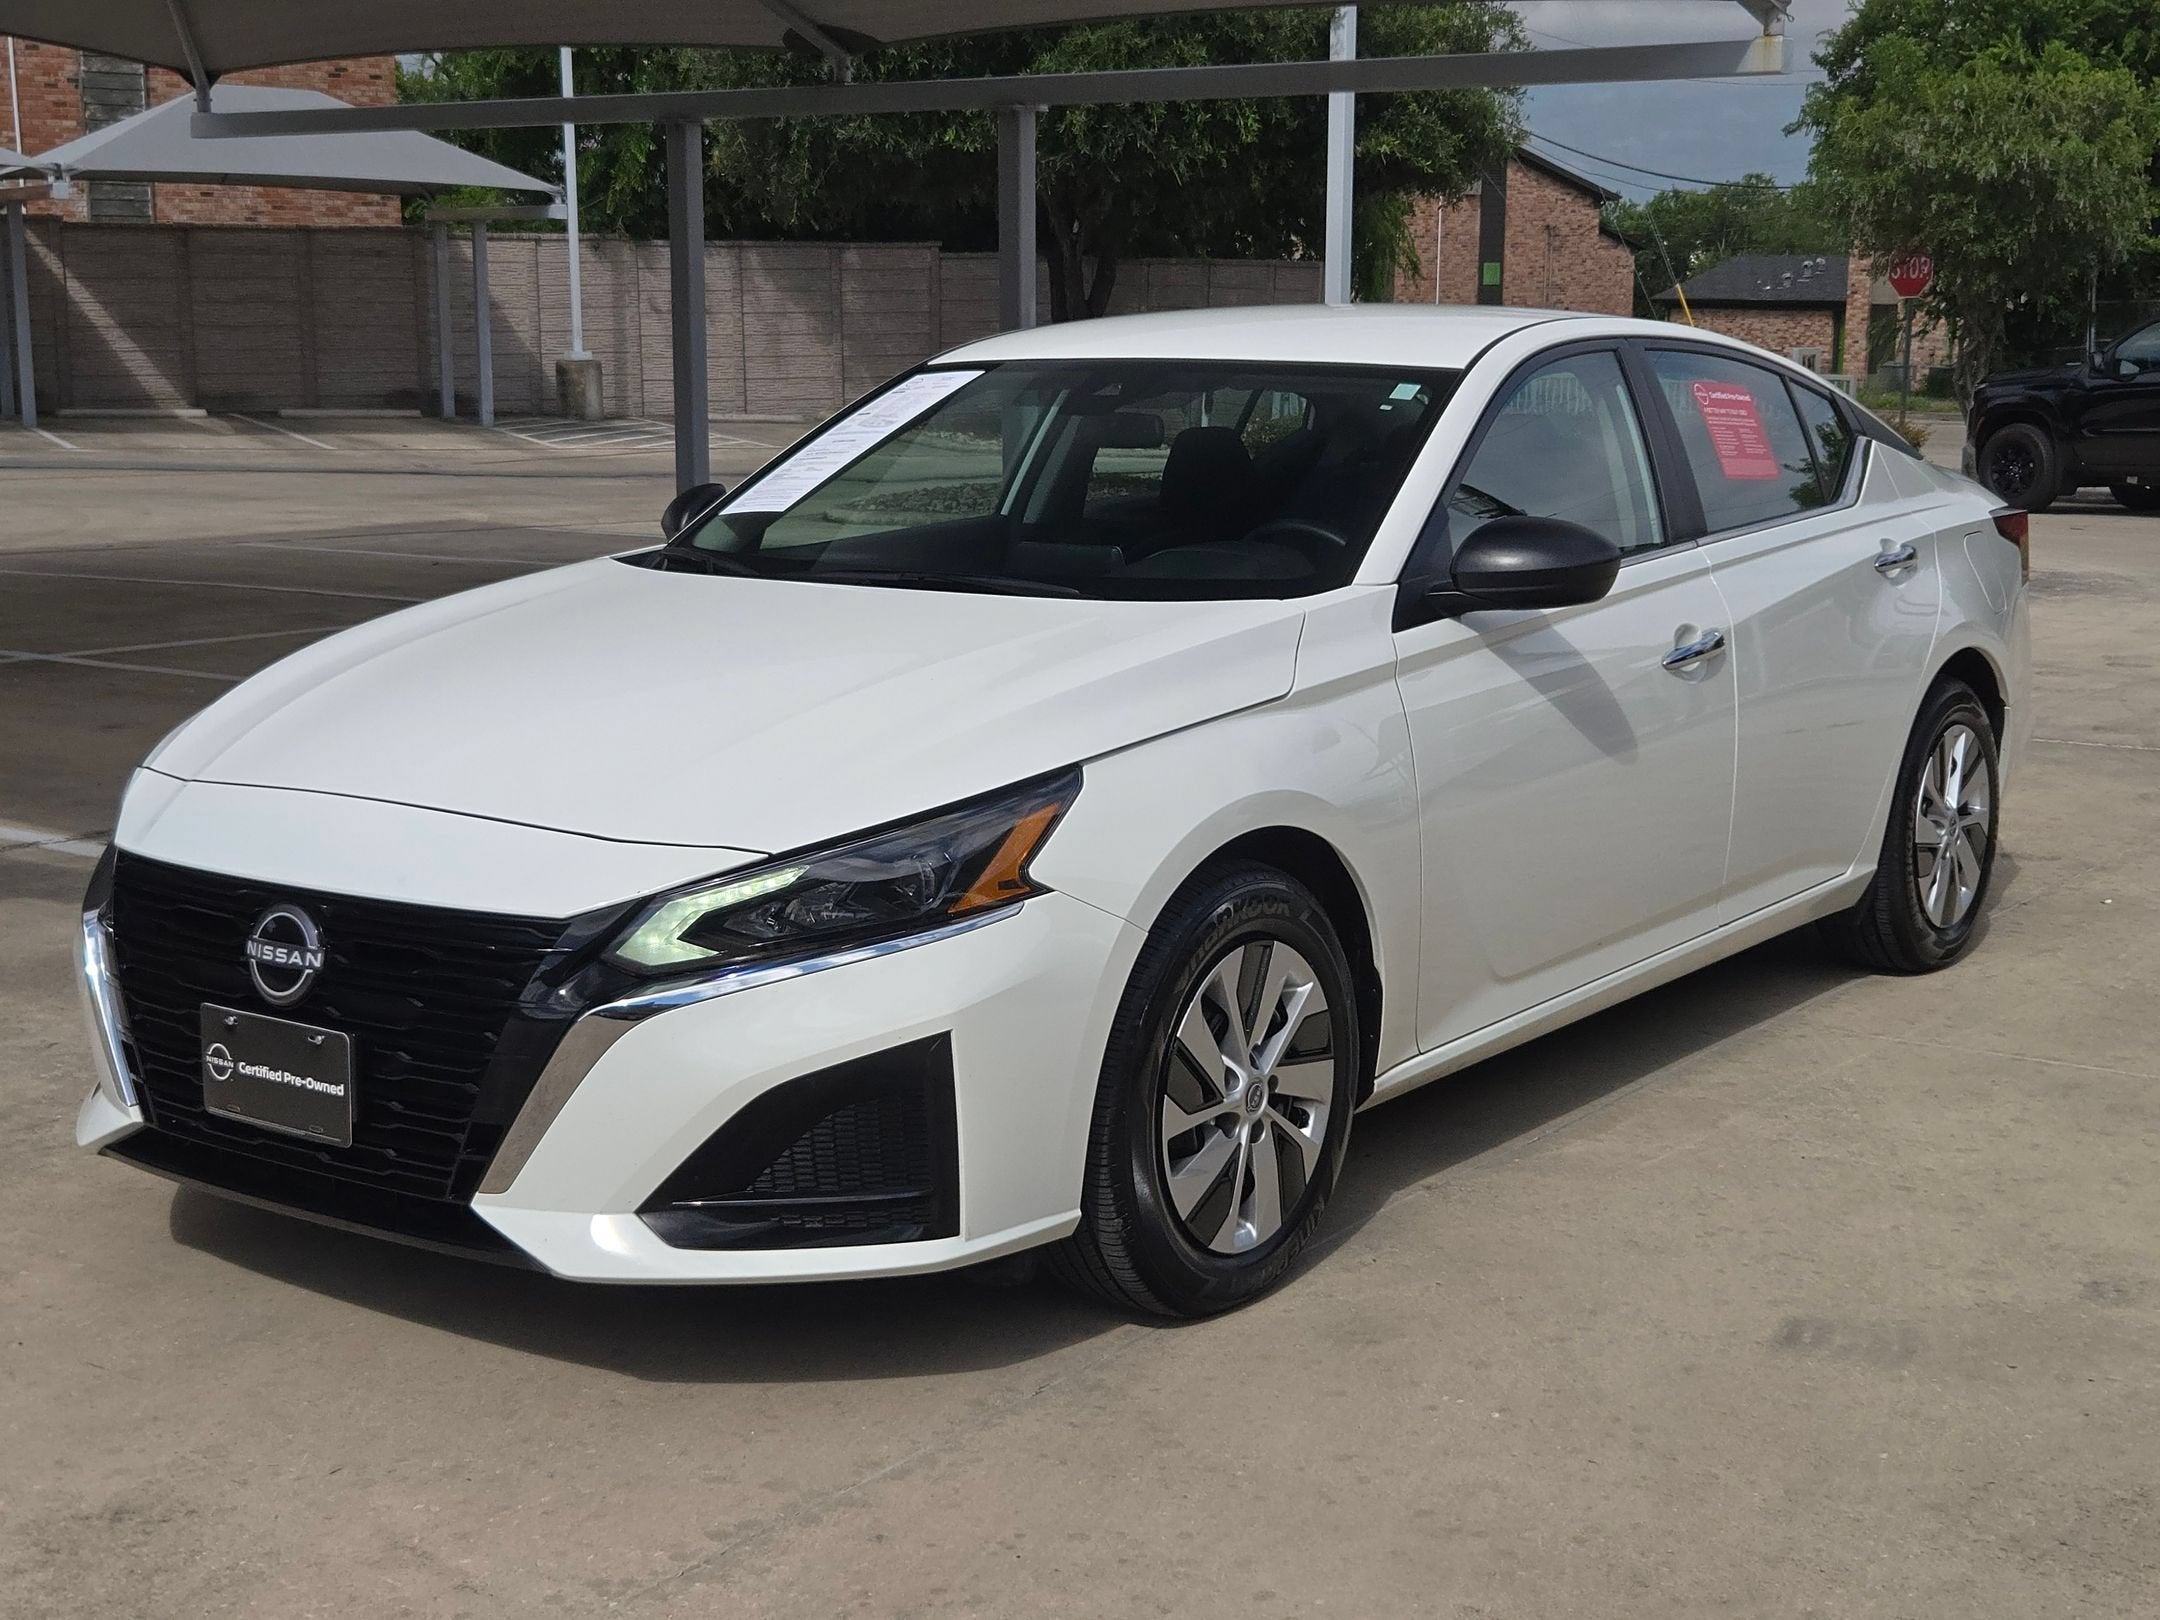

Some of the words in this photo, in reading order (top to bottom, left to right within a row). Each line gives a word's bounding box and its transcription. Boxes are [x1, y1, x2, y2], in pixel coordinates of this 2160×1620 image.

[1891, 256, 1930, 279] STOP
[247, 940, 322, 968] NISSAN
[206, 1055, 234, 1068] NISSAN
[239, 1061, 282, 1082] Certified
[283, 1072, 344, 1096] Pre-Owned
